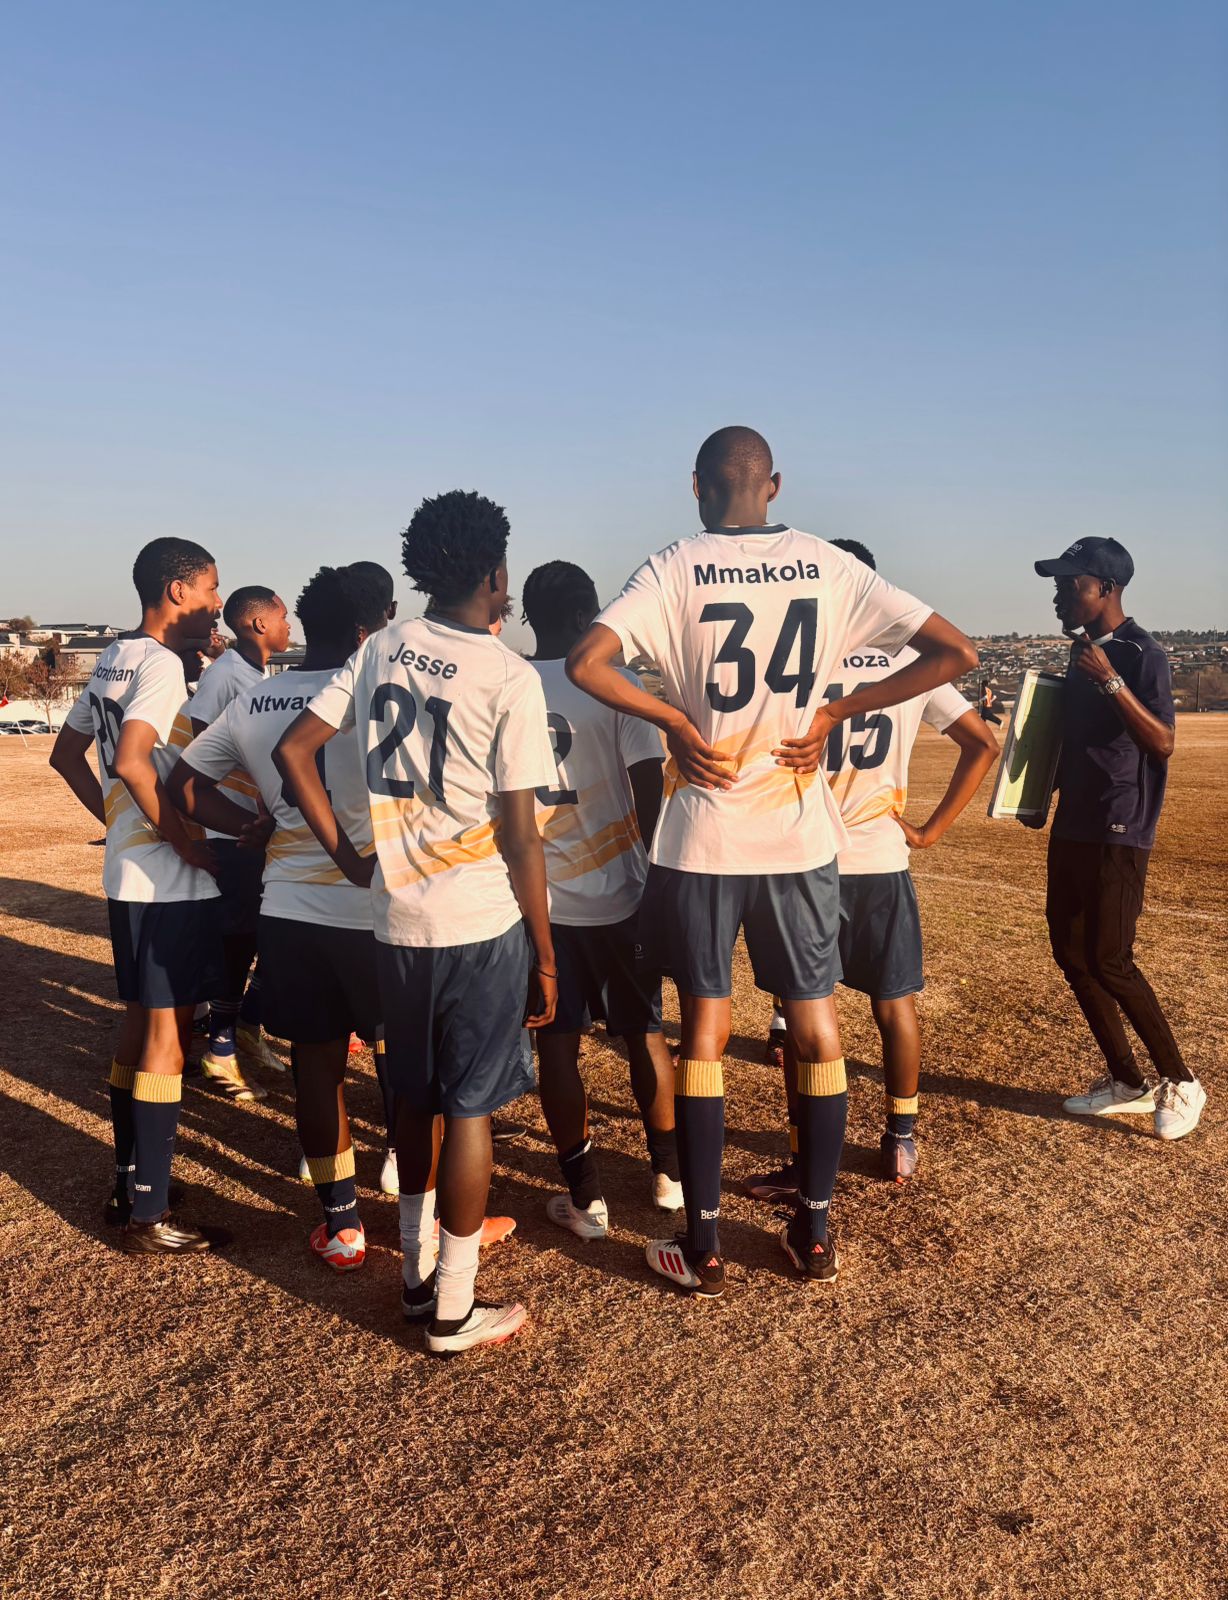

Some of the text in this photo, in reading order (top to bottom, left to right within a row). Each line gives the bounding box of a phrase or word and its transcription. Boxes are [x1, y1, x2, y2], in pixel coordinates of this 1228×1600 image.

[693, 560, 820, 585] Mmakola
[389, 642, 458, 680] Jesse
[699, 598, 818, 713] 34
[842, 655, 890, 669] oza
[366, 682, 453, 802] 21
[822, 681, 893, 771] 15
